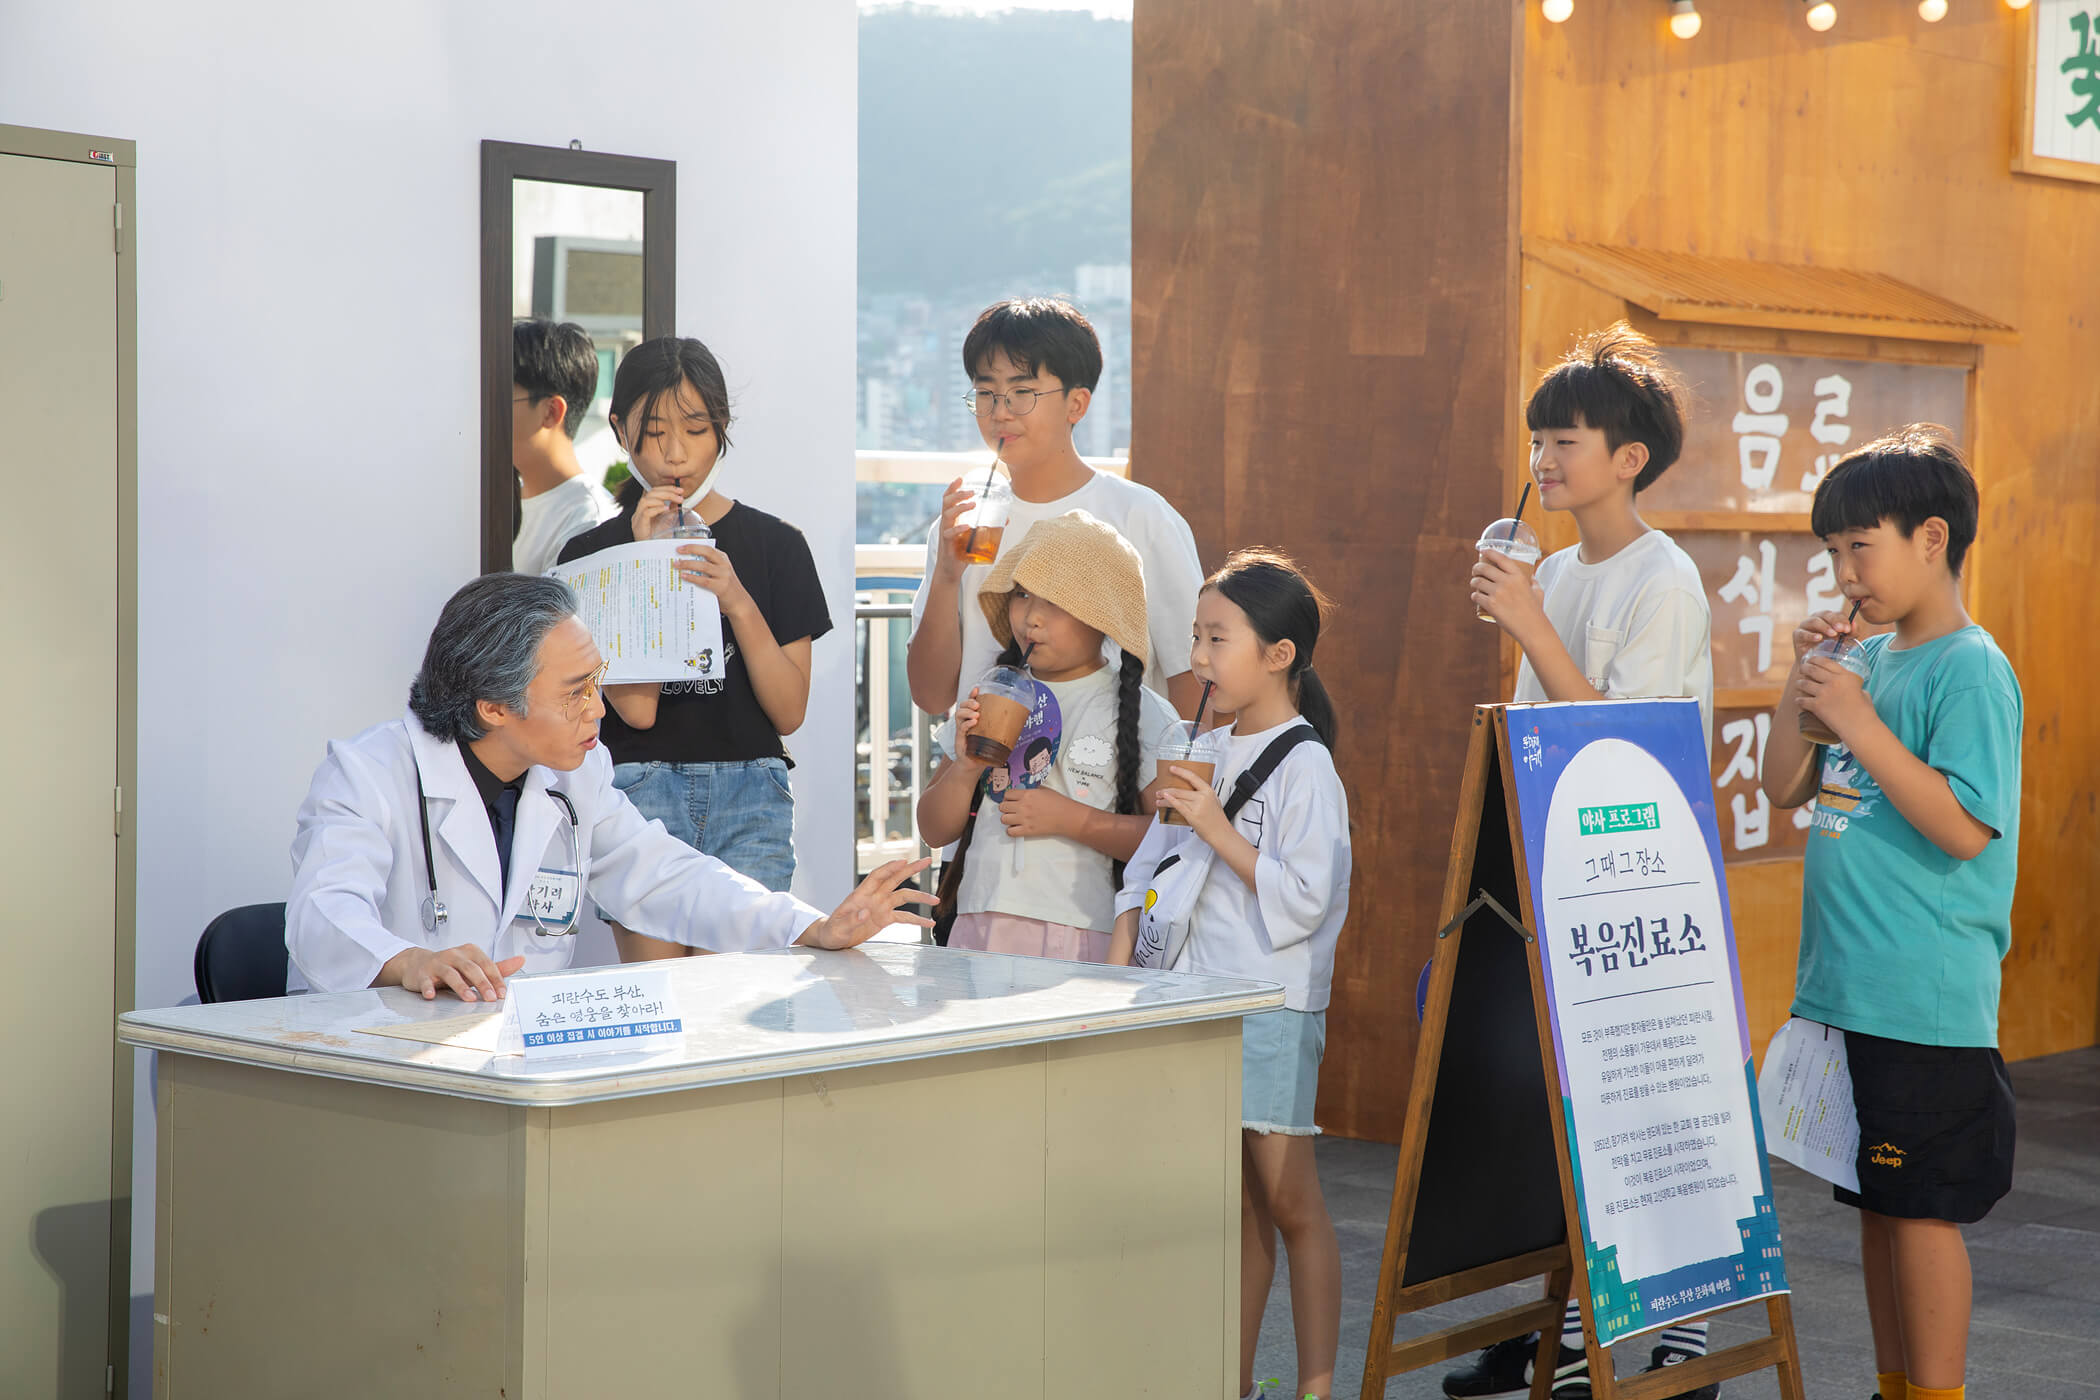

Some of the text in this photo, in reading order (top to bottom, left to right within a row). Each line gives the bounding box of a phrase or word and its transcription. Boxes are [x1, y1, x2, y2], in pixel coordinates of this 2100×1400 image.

[661, 679, 723, 695] LOVELY
[1582, 804, 1657, 832] 야사 프로그램
[1569, 913, 1706, 976] 복음진료소
[552, 984, 645, 1005] 피란수도 부산,
[536, 1001, 664, 1027] 숨은 영웅을 찾아라!
[529, 1023, 678, 1045] 5인 이상 집결 시 이야기를 시작합니다.
[1872, 1153, 1902, 1168] Jeep
[1650, 1278, 1731, 1312] 피란수도 부산 문화재 야행
